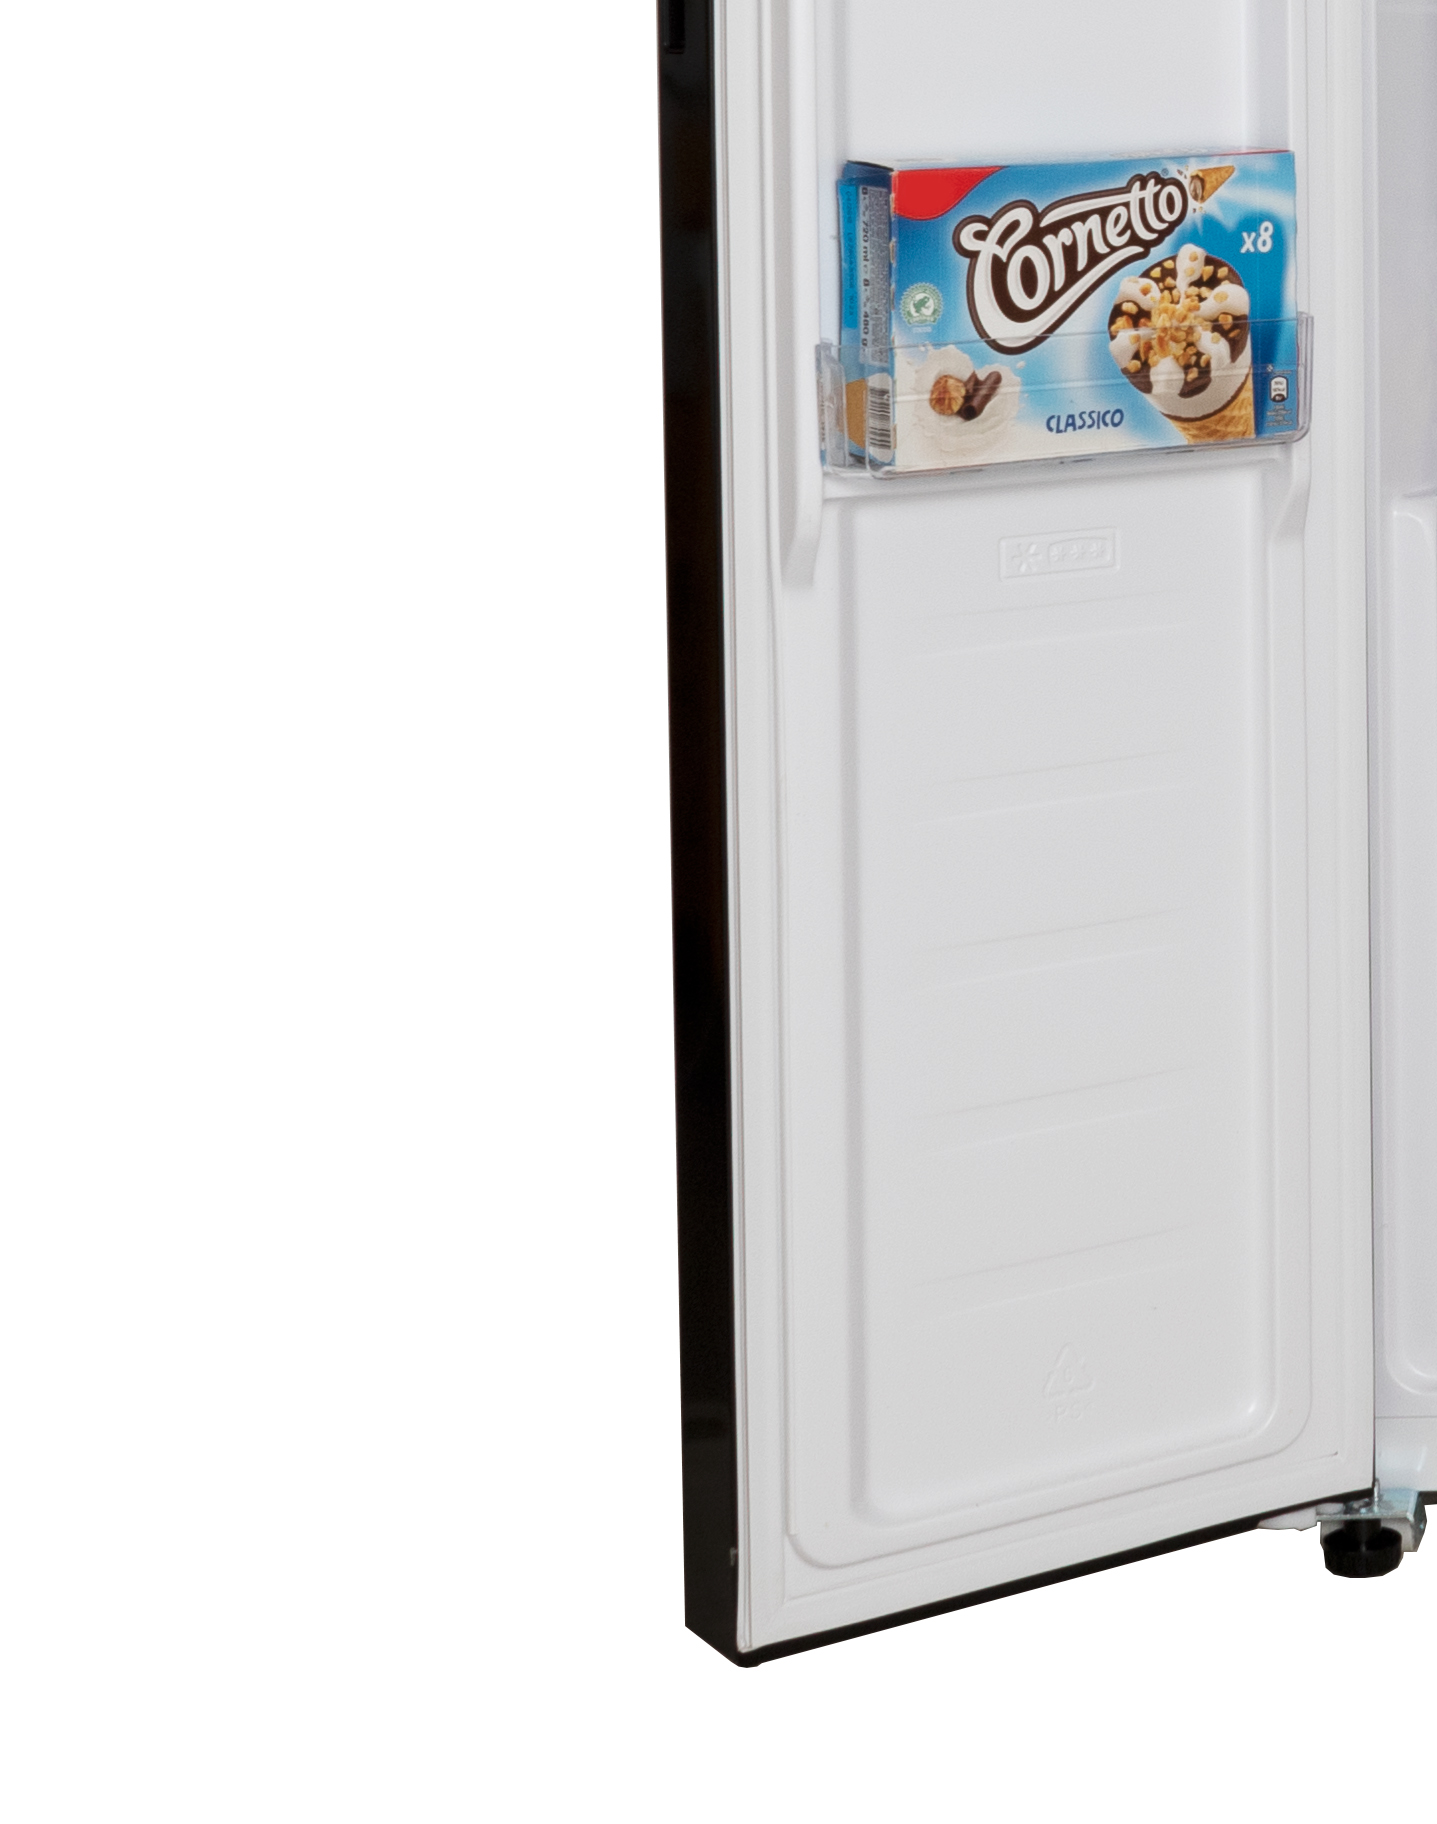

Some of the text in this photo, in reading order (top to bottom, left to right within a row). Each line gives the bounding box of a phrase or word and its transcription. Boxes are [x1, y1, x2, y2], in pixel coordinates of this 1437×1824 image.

[1240, 221, 1274, 254] x8
[956, 172, 1185, 349] Cornetto
[1046, 408, 1124, 435] CLASSICO
